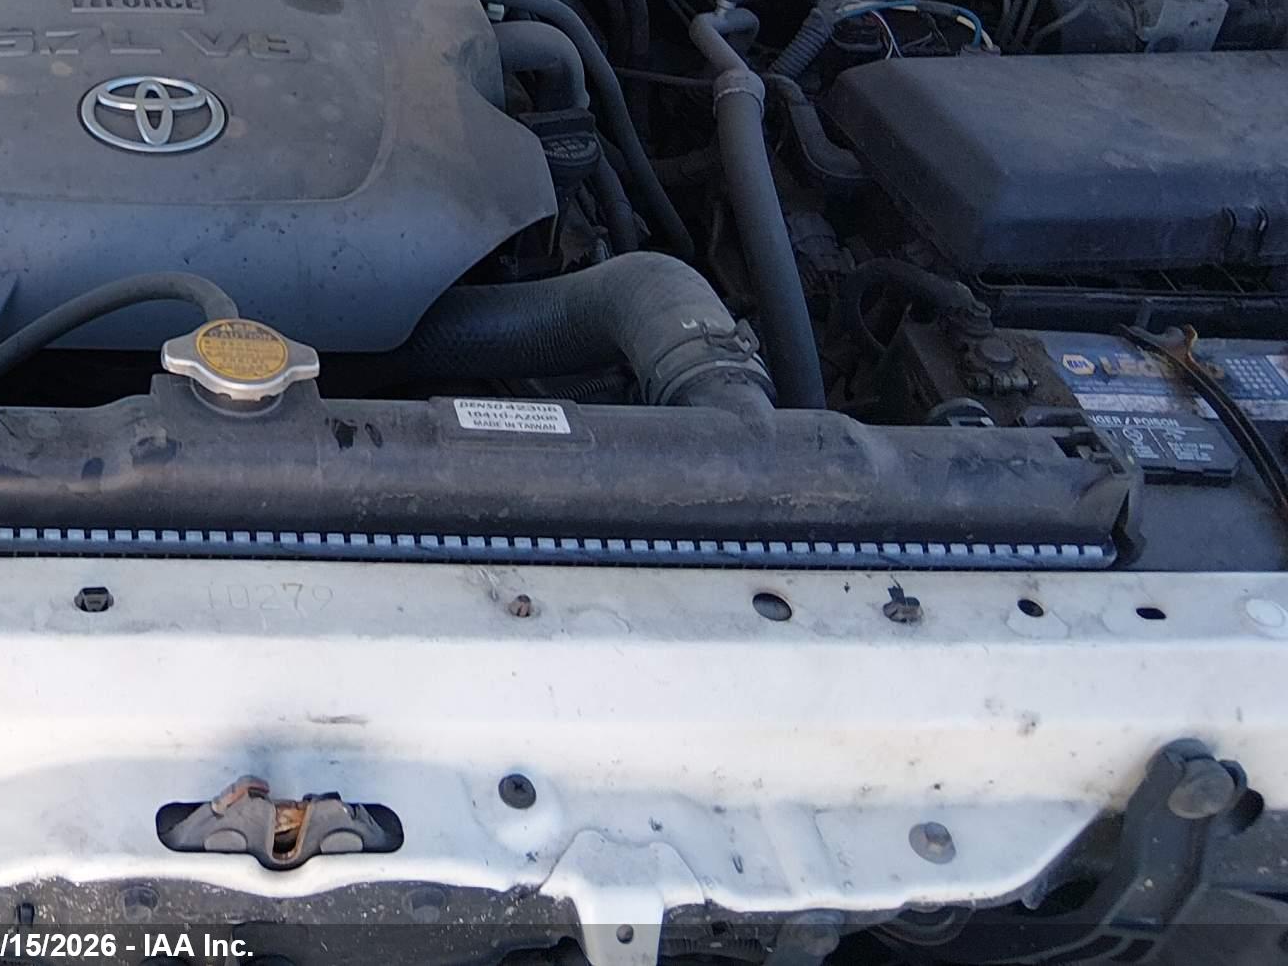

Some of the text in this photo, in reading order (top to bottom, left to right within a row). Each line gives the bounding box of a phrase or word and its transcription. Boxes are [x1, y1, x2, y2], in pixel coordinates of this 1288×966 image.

[179, 29, 311, 63] V8
[459, 401, 503, 410] DENSO
[473, 419, 557, 431] MADE IN TAIWAN
[1088, 414, 1122, 425] NGER
[1133, 416, 1180, 427] POISON
